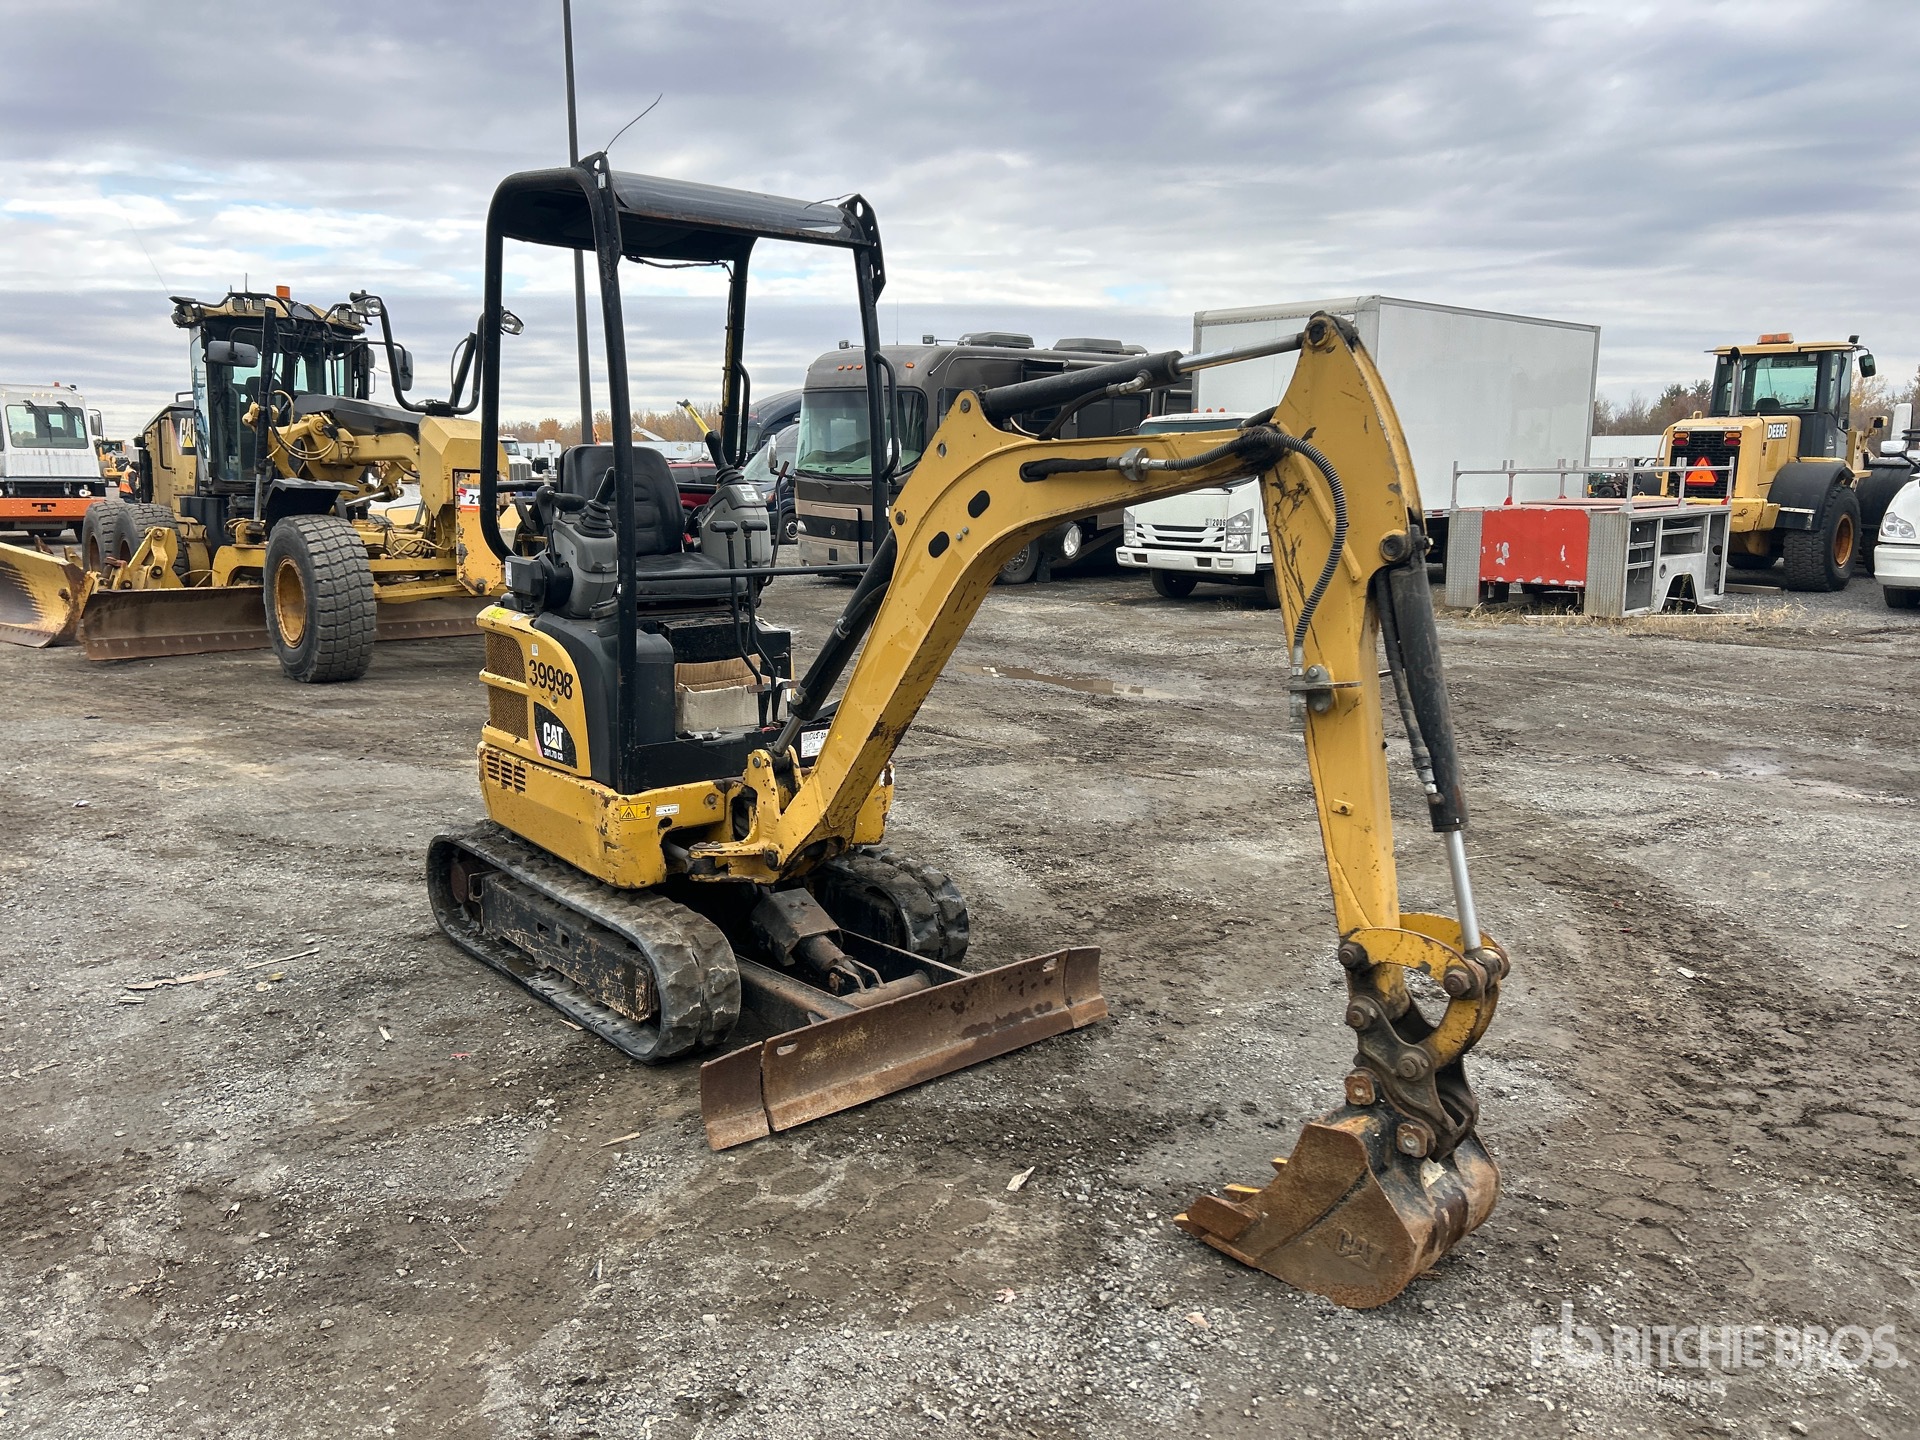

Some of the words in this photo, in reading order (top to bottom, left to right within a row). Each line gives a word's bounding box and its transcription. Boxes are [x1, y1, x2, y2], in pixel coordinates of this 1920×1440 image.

[1767, 423, 1787, 439] DEERE
[529, 659, 573, 700] 39998
[543, 722, 563, 751] CAT
[1335, 1227, 1385, 1271] CAT
